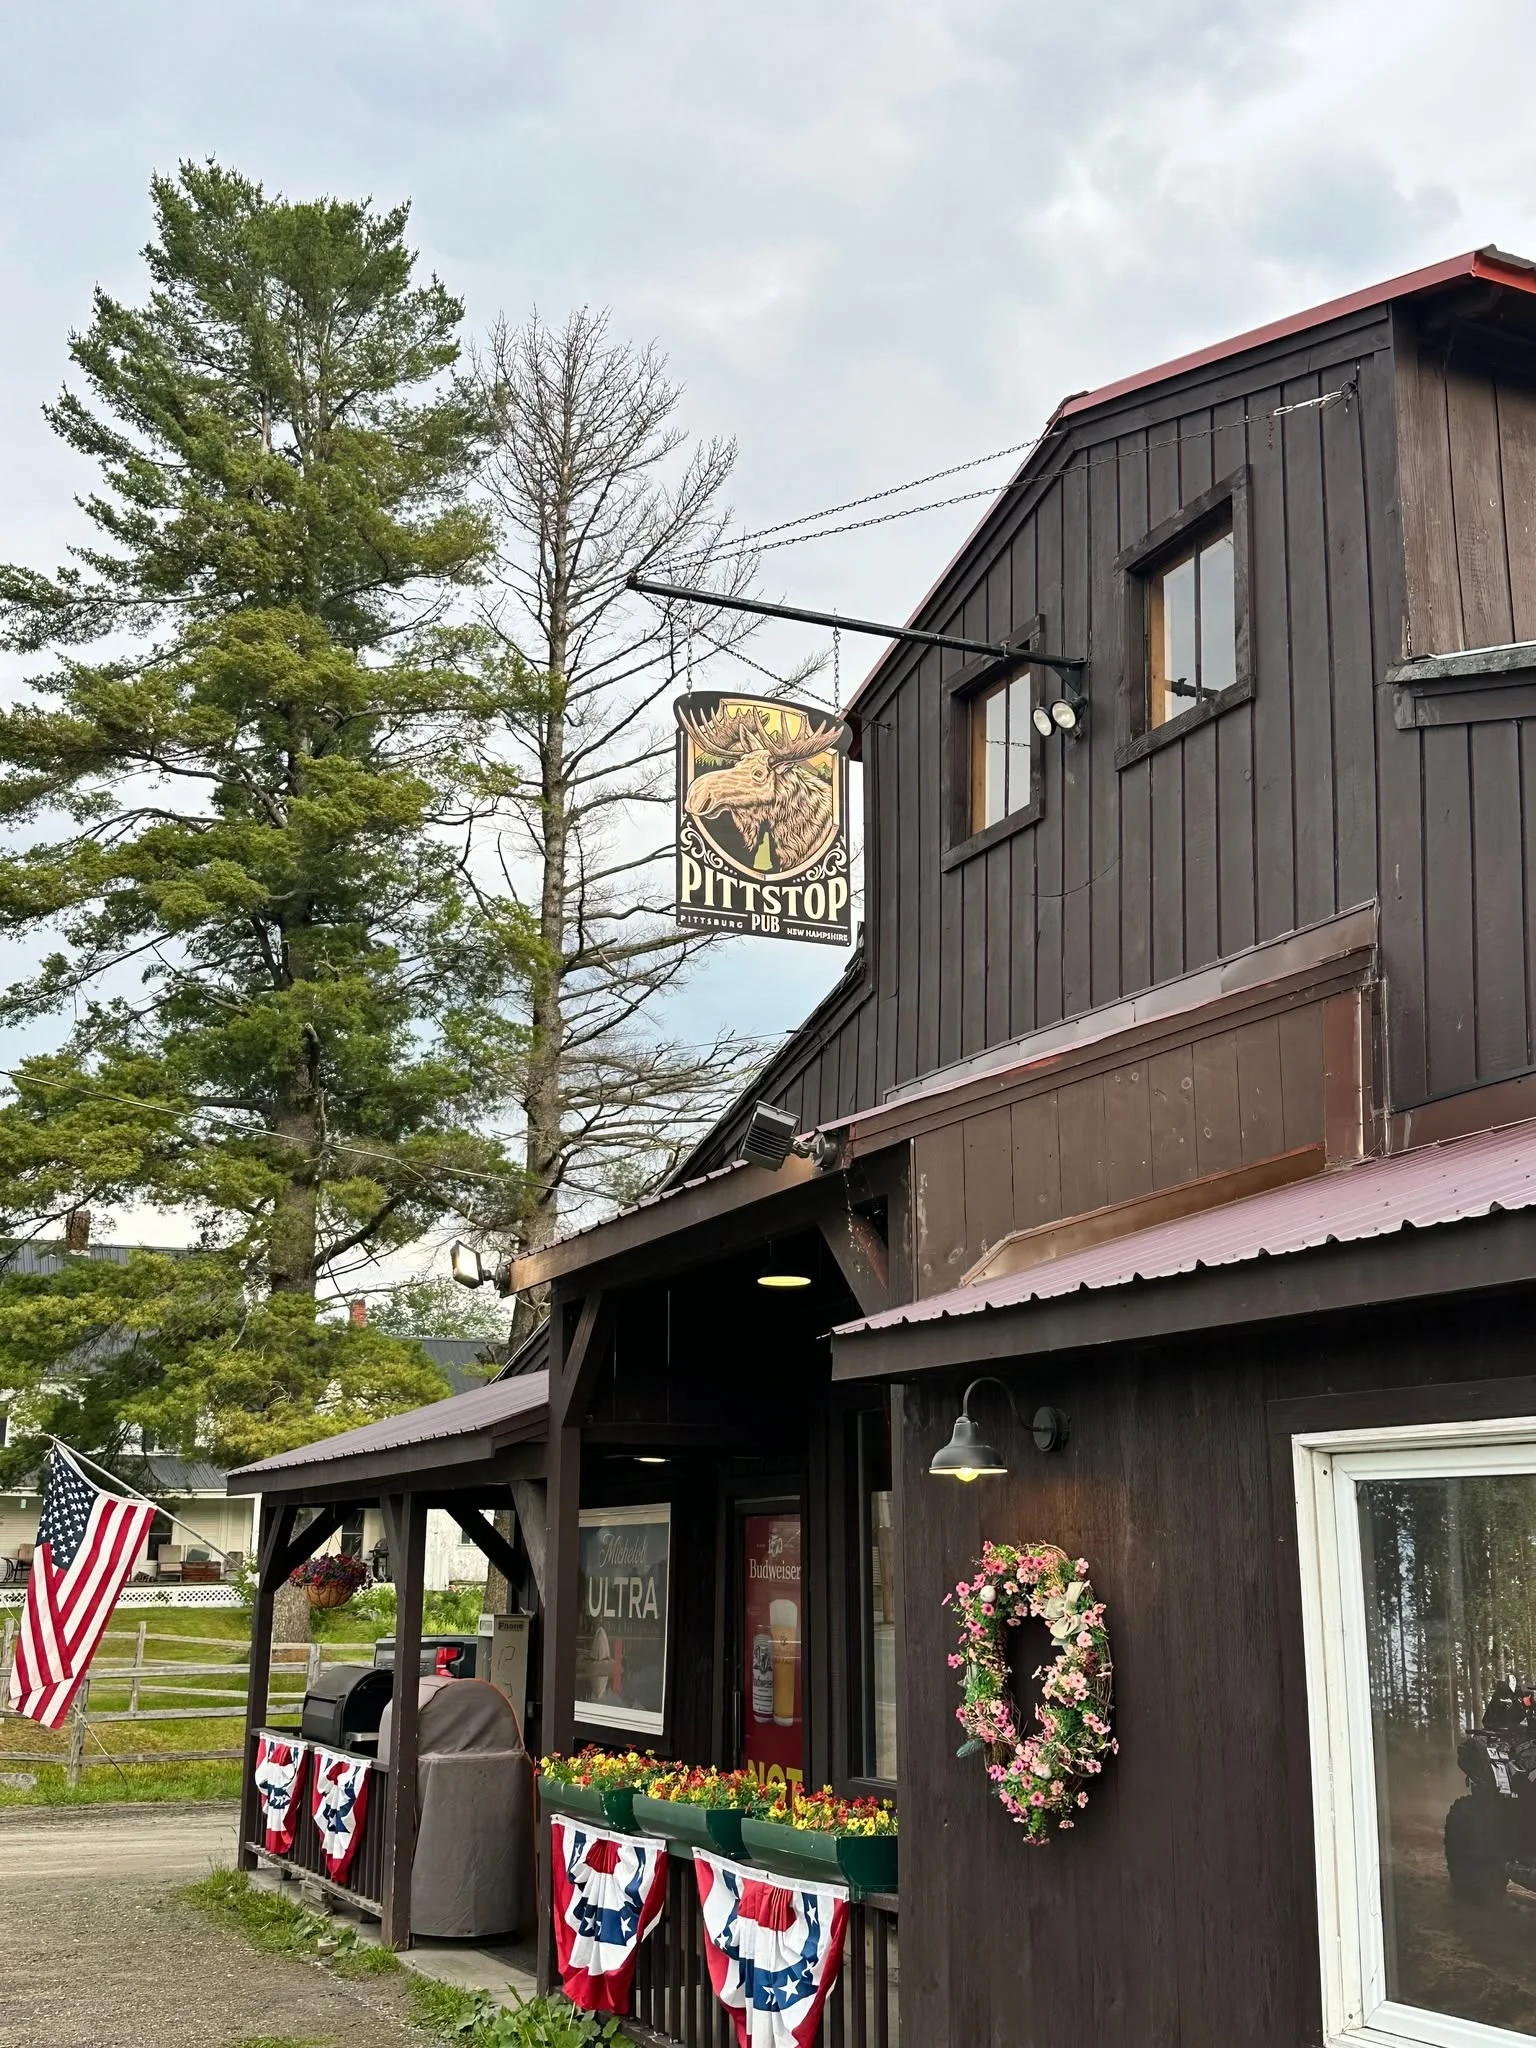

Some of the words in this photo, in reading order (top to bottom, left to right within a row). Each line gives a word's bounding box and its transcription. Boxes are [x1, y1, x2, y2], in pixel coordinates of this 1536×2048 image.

[680, 851, 848, 921] PITTSTOP
[680, 914, 743, 929] PITTSBURG
[751, 914, 780, 933] PUB
[787, 928, 805, 936] NEW
[806, 930, 848, 941] HAMPSHIRE
[748, 1558, 801, 1580] Budweiser
[588, 1576, 659, 1619] ULTRA
